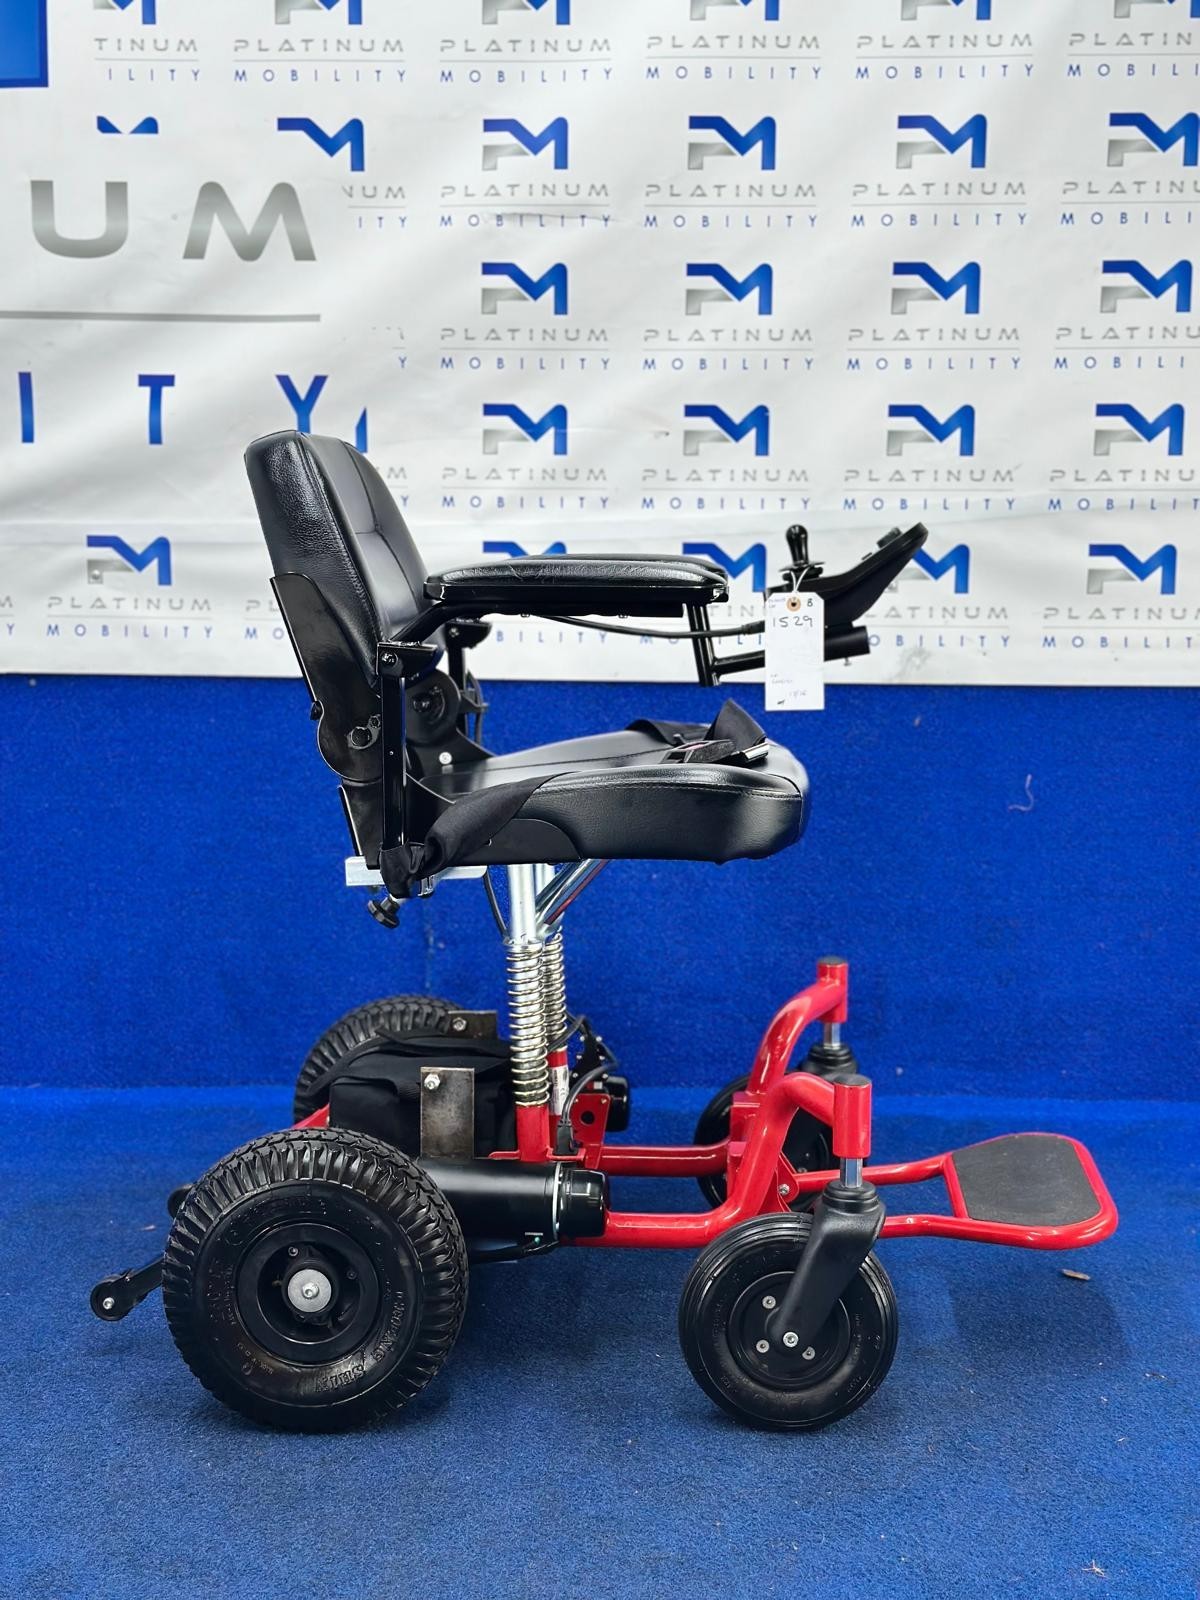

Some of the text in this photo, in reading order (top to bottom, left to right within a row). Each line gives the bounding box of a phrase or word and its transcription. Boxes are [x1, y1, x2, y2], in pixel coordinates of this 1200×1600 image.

[234, 39, 403, 52] PLATINUM
[440, 39, 610, 52] PLATINUM
[648, 35, 819, 49] PLATINUM
[857, 34, 1032, 48] PLATINUM
[234, 69, 405, 82] MOBILITY
[440, 68, 611, 83] MOBILITY
[647, 66, 821, 79] MOBILITY
[856, 64, 1033, 79] MOBILITY
[441, 184, 609, 197] PLATINUM
[645, 184, 815, 197] PLATINUM
[853, 182, 1026, 196] PLATINUM
[440, 213, 611, 228] MOBILITY
[644, 215, 816, 227] MOBILITY
[852, 213, 1026, 226] MOBILITY
[441, 328, 607, 341] PLATINUM
[644, 328, 813, 342] PLATINUM
[848, 328, 1019, 341] PLATINUM
[441, 357, 609, 370] MOBILITY
[643, 358, 813, 370] MOBILITY
[847, 357, 1020, 370] MOBILITY
[442, 468, 607, 481] PLATINUM
[642, 469, 808, 482] PLATINUM
[844, 469, 1014, 482] PLATINUM
[442, 496, 608, 508] MOBILITY
[642, 497, 810, 509] MOBILITY
[844, 498, 1015, 510] MOBILITY
[46, 597, 212, 611] PLATINUM
[773, 615, 813, 628] 1529
[47, 624, 212, 638] MOBILITY
